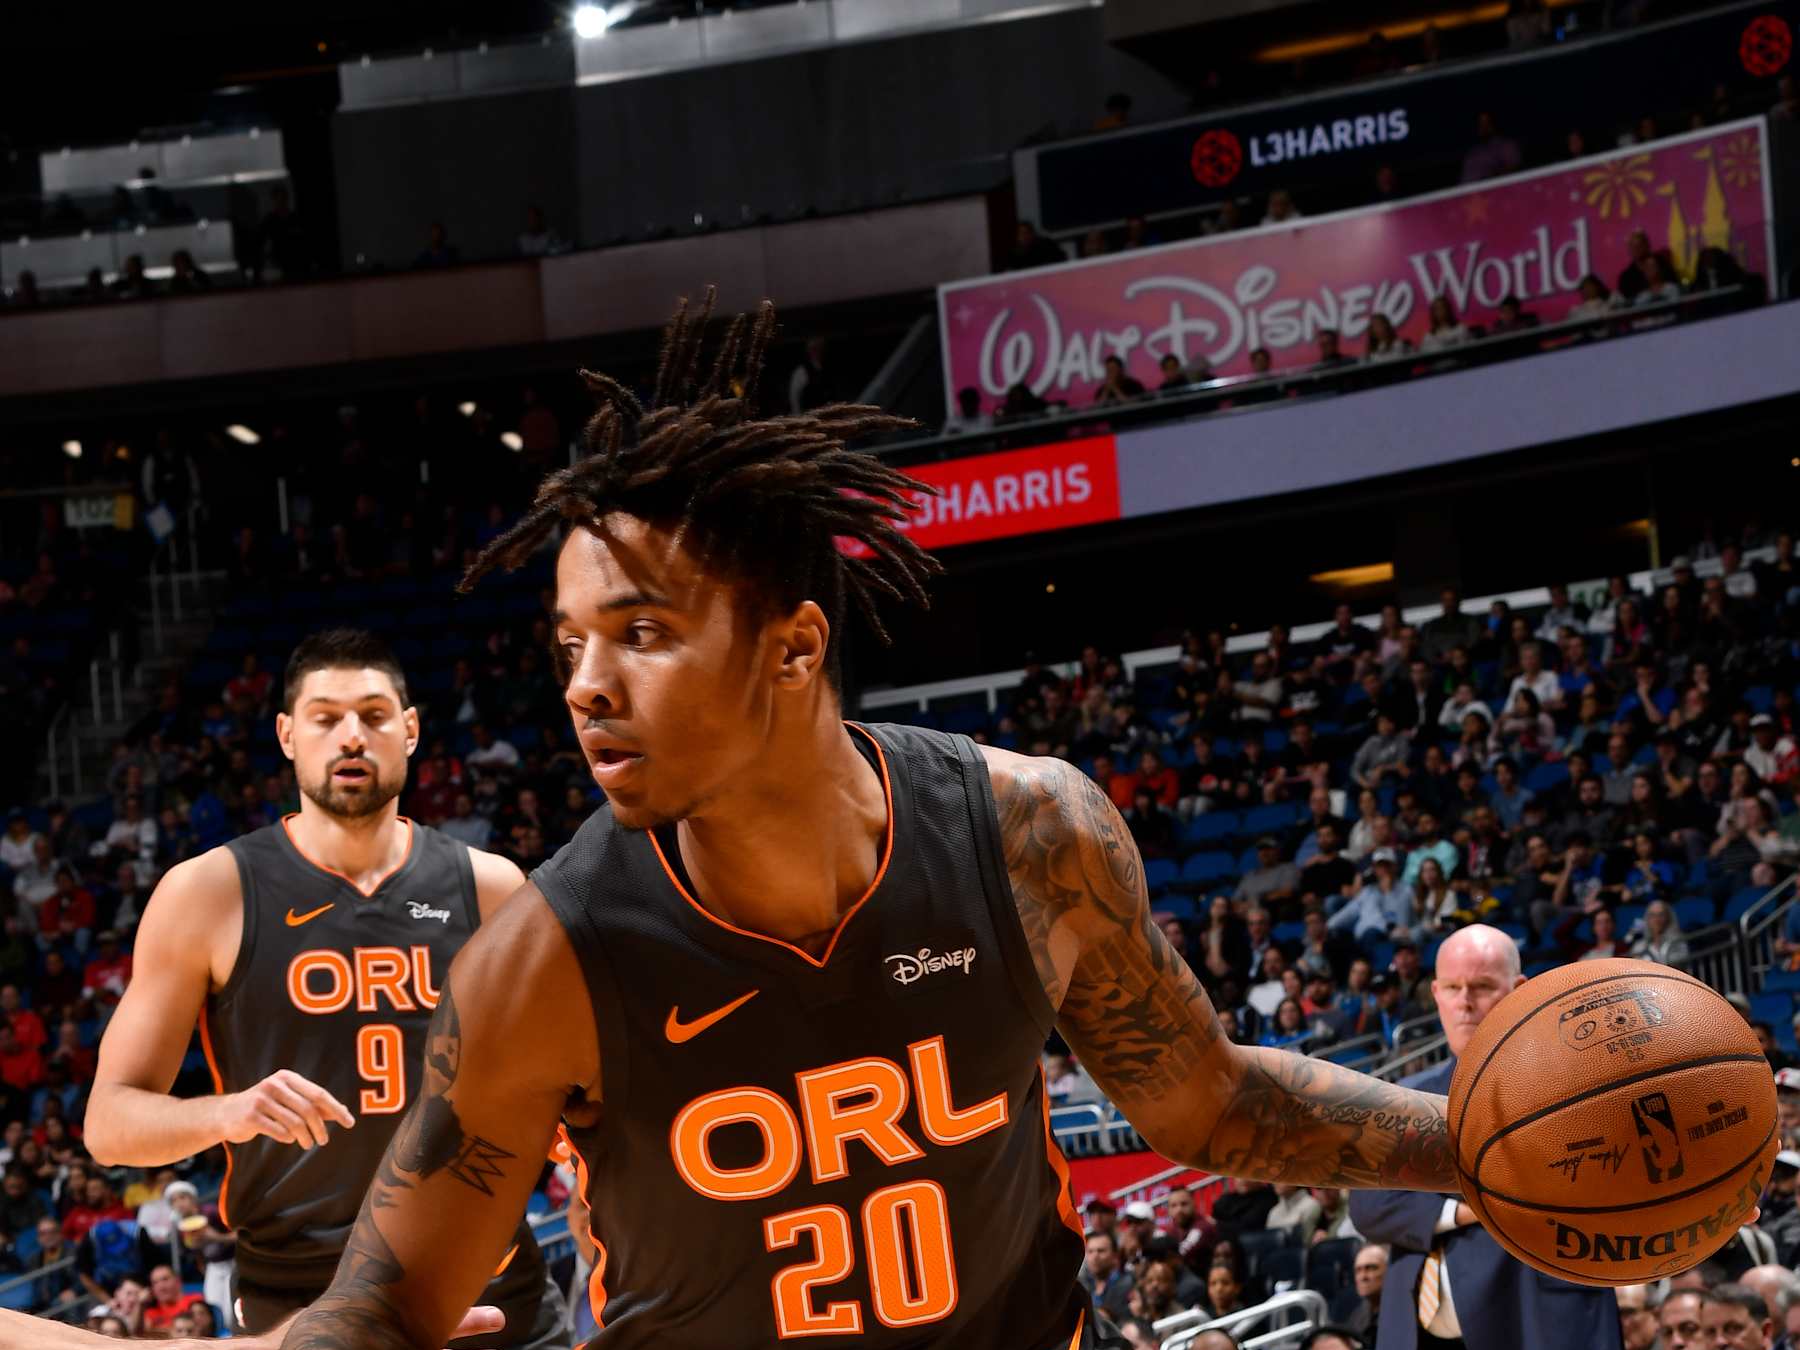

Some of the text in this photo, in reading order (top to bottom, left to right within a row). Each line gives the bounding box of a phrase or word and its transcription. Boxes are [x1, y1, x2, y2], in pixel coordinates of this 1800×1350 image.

[1250, 108, 1409, 166] L3HARRIS
[1411, 217, 1590, 310] World
[286, 944, 441, 1015] ORL
[355, 1023, 407, 1115] 9
[669, 1034, 1009, 1201] ORL
[1556, 1161, 1764, 1263] SPALDING
[762, 1179, 959, 1340] 20
